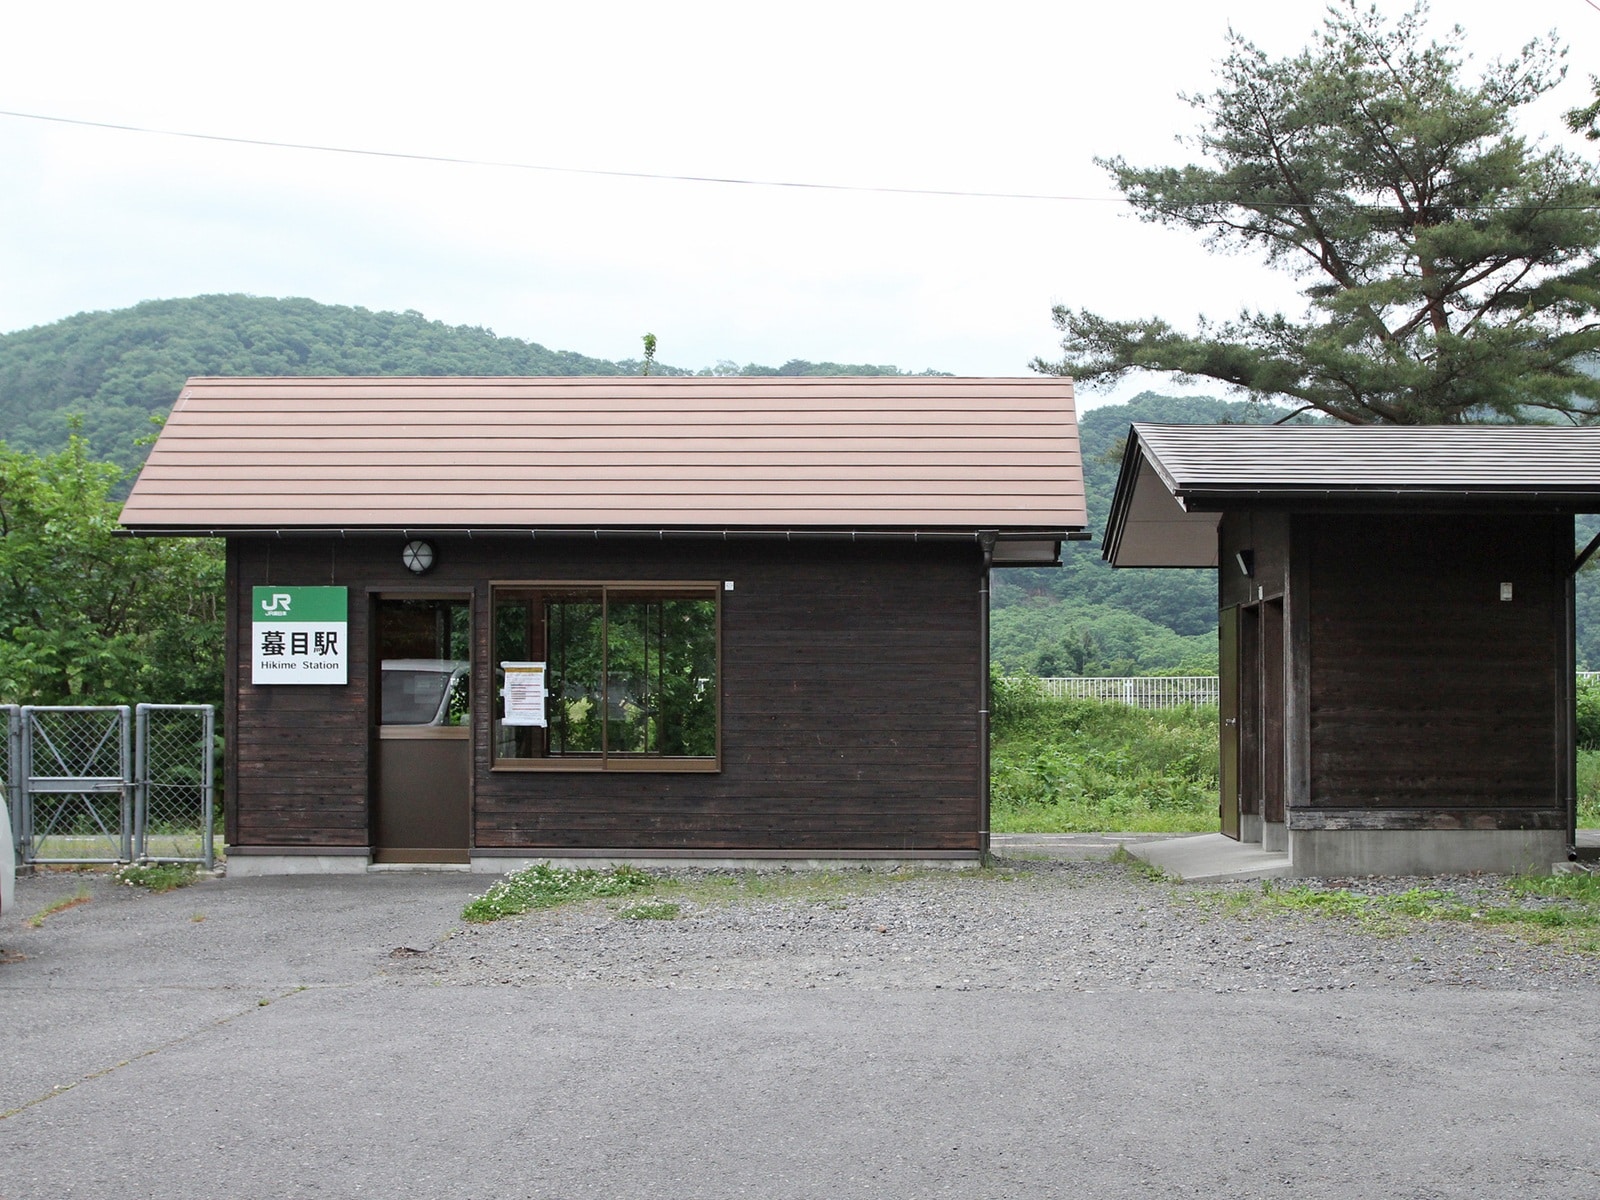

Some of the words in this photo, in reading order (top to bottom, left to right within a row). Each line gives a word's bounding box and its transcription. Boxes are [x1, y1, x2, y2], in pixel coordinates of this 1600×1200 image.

[262, 594, 291, 611] JR
[261, 631, 338, 656] 蟇目駅
[261, 661, 297, 670] Hikime
[302, 661, 339, 670] Station
